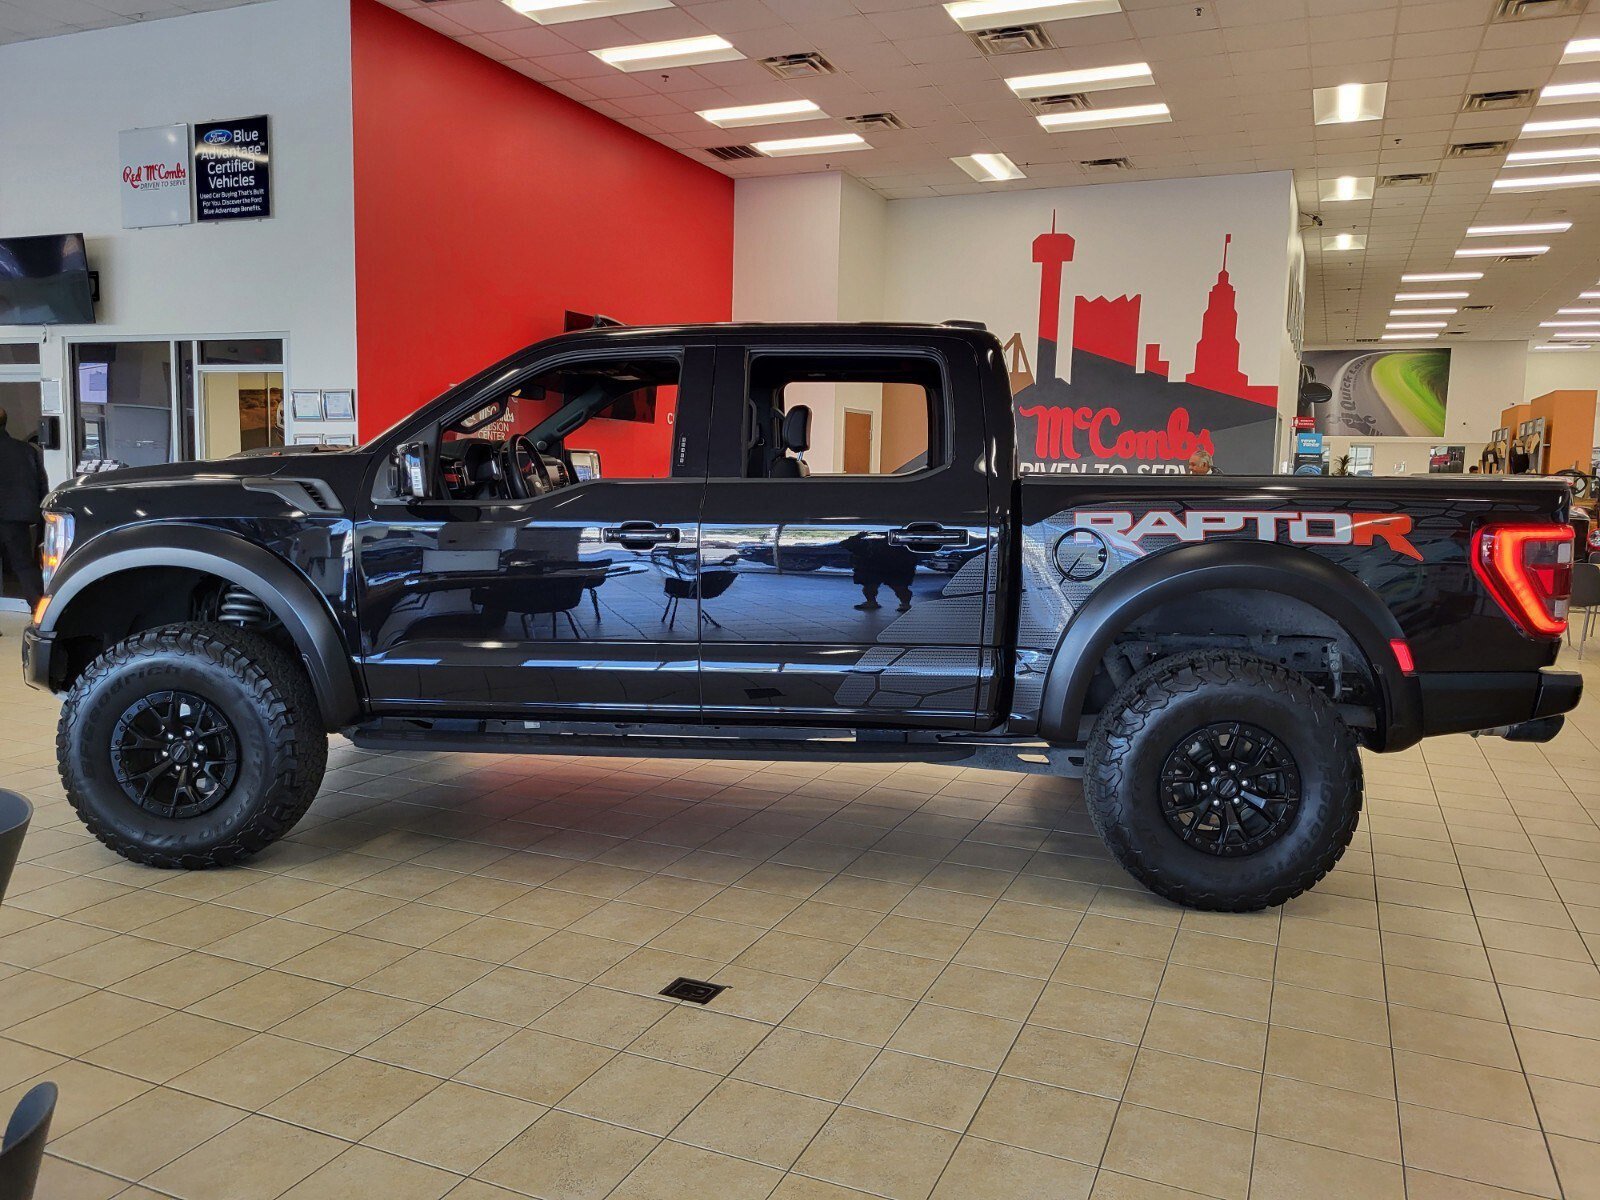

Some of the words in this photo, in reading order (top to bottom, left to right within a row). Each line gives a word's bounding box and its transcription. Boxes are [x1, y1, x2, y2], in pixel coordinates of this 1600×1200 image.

[208, 132, 227, 143] Ford
[233, 128, 259, 143] Blue
[207, 158, 255, 175] Certified
[123, 165, 142, 189] Red
[143, 162, 186, 181] McCombs
[208, 173, 255, 189] Vehicles
[140, 181, 160, 190] DRIVEN
[161, 180, 169, 188] TO
[170, 179, 186, 187] SERVE
[221, 190, 238, 199] Buying
[221, 198, 242, 206] Discover
[203, 207, 214, 215] Blue
[214, 206, 240, 214] Advantage
[1340, 375, 1357, 411] Quick
[478, 431, 505, 440] CENTER
[1018, 405, 1215, 460] McCombs
[1073, 510, 1425, 562] RAPTOR
